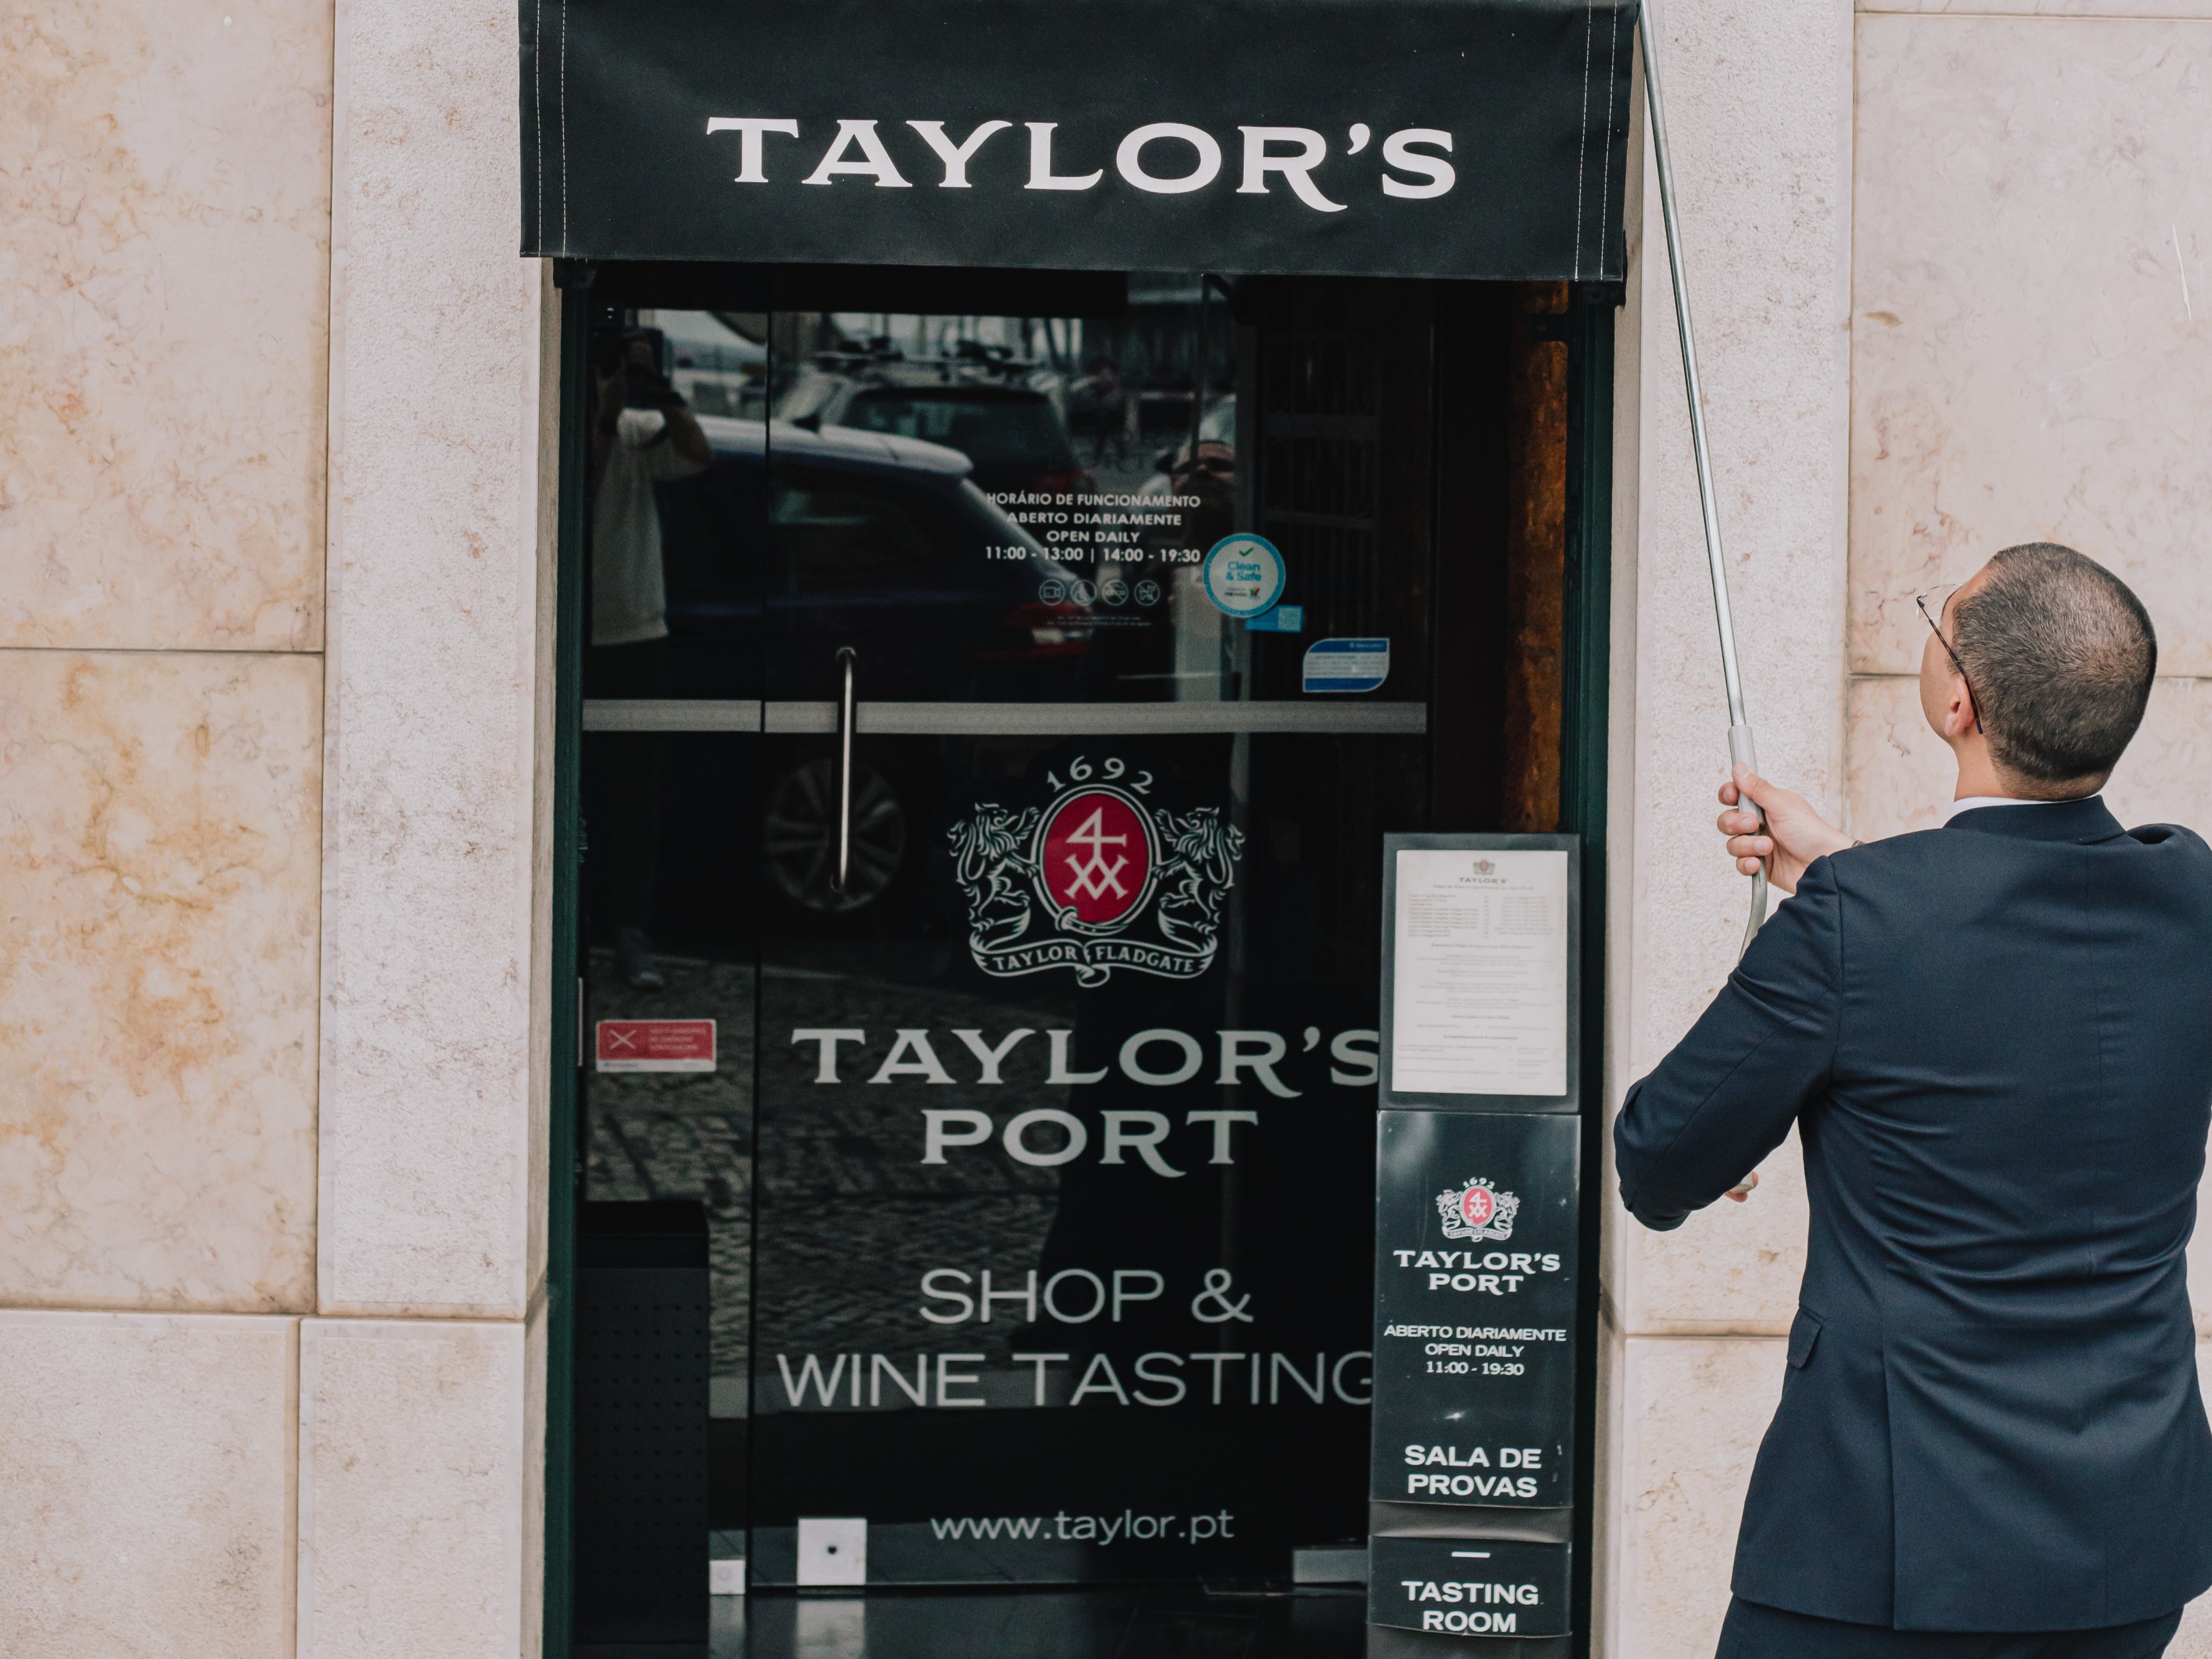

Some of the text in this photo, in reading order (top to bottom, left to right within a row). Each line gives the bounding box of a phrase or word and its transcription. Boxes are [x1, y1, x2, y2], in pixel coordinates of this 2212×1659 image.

[706, 116, 1456, 213] TAYLOR'S
[986, 490, 1201, 508] HORÁRIO DE FUNCIONAMENTO
[1006, 512, 1182, 526] ABERTO DIARIAMENTE
[1046, 530, 1141, 543] OPEN DAILY
[986, 546, 1027, 560] 11:00
[1043, 546, 1084, 561] 13:00
[1103, 548, 1144, 561] 14:00
[1160, 548, 1201, 562] 19:30
[1228, 561, 1261, 571] Clean
[1047, 755, 1154, 795] 1692
[992, 946, 1195, 972] TAYLOR FLADGATE
[791, 1026, 1379, 1098] TAYLOR'S
[919, 1108, 1259, 1178] PORT
[1463, 1176, 1495, 1189] 1692
[1393, 1250, 1561, 1275] TAYLOR'S
[918, 1267, 1254, 1324] SHOP &
[1428, 1273, 1524, 1295] PORT
[1384, 1325, 1567, 1341] ABERTO DIARIAMENTE
[1425, 1343, 1524, 1357] OPEN DAILY
[776, 1351, 1372, 1408] WINE TASTING
[1426, 1360, 1469, 1374] 11:00
[1482, 1362, 1524, 1376] 19:30
[1404, 1444, 1542, 1469] SALA DE
[1408, 1474, 1537, 1498] PROVAS
[931, 1509, 1234, 1546] www.taylor.pt
[1401, 1580, 1539, 1605] TASTING
[1422, 1610, 1517, 1633] ROOM
